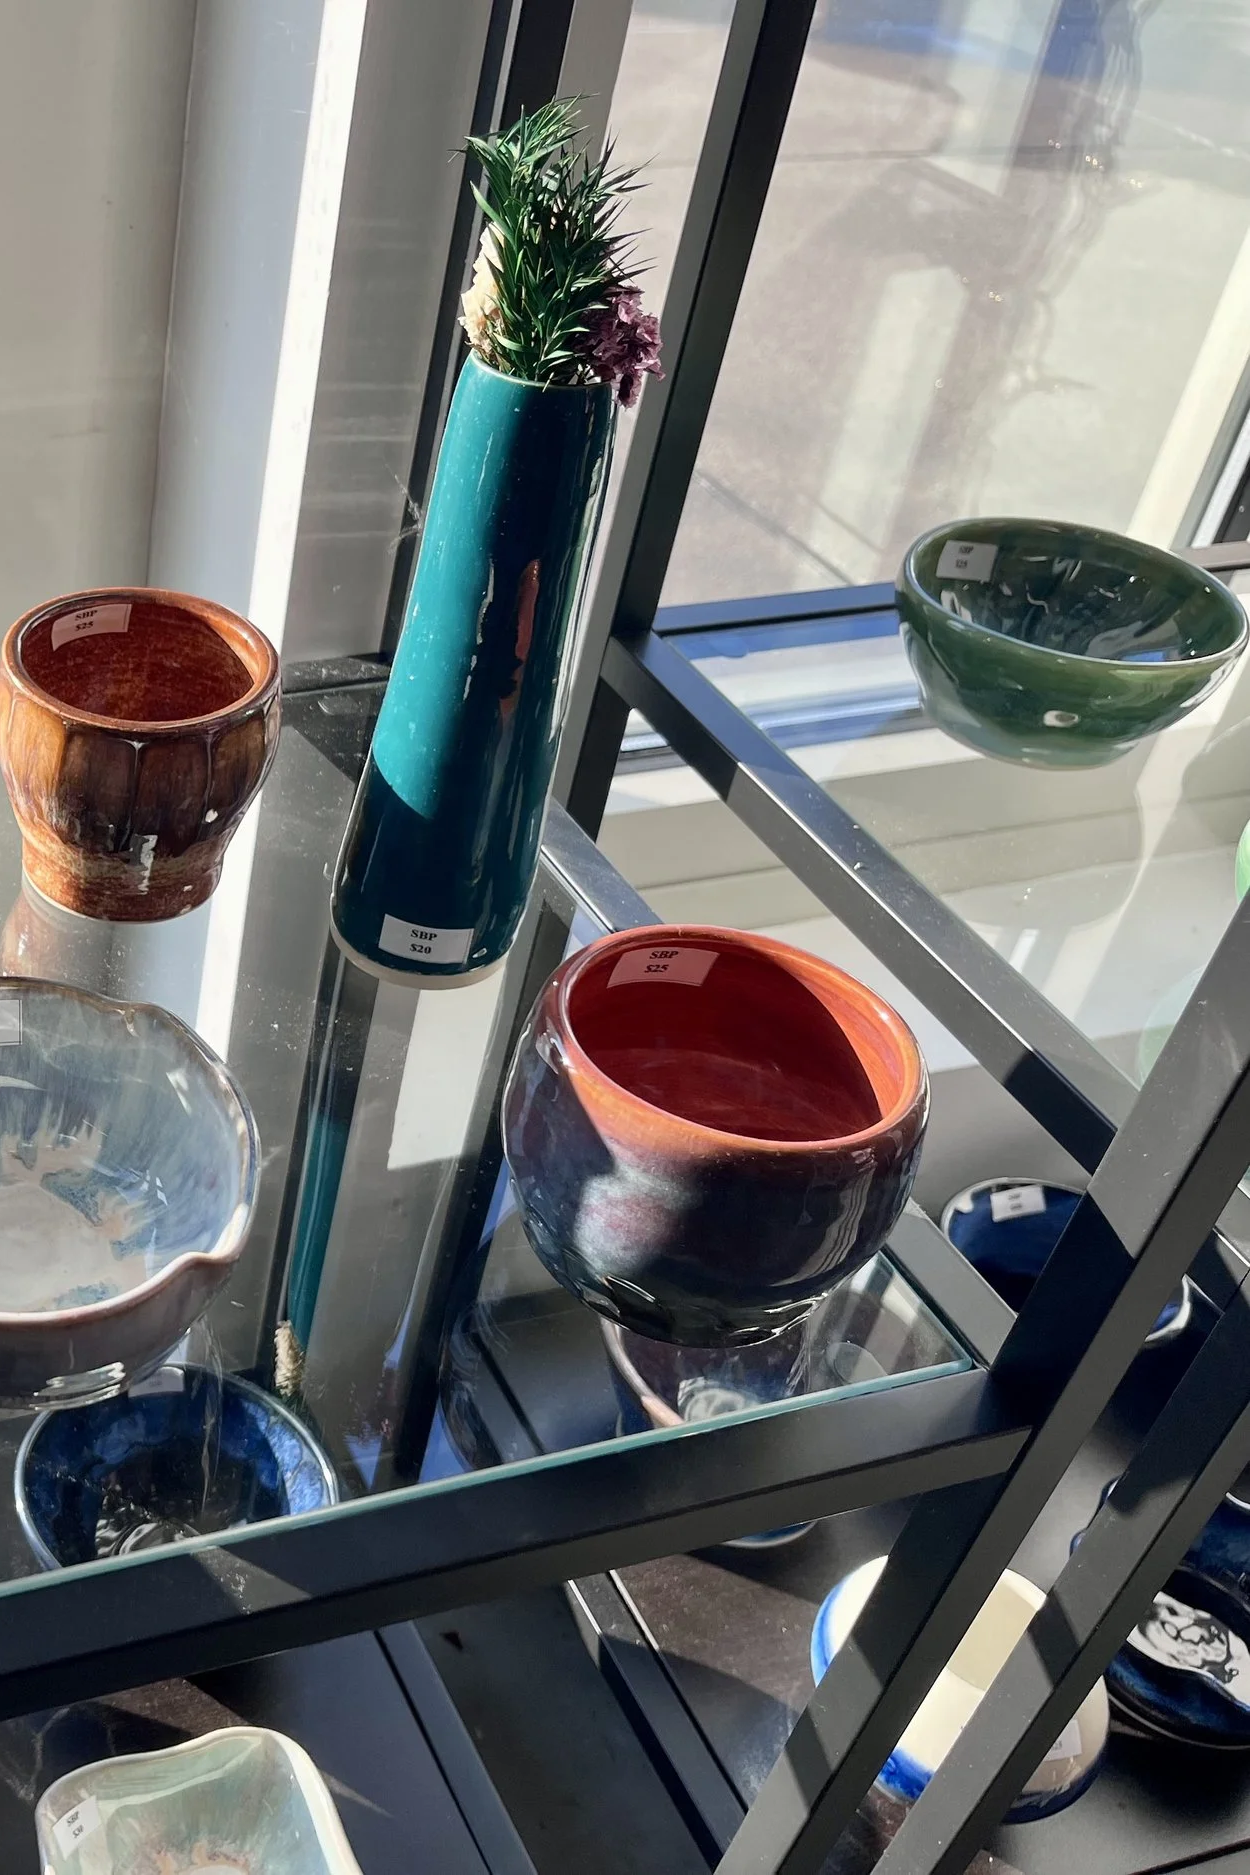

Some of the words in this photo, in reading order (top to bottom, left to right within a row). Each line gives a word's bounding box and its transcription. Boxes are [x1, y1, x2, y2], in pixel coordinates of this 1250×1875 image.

[74, 610, 98, 620] SBP
[75, 621, 94, 631] $25
[410, 929, 438, 941] SBP
[410, 943, 432, 954] $20
[649, 950, 679, 960] SBP
[643, 964, 670, 974] $25
